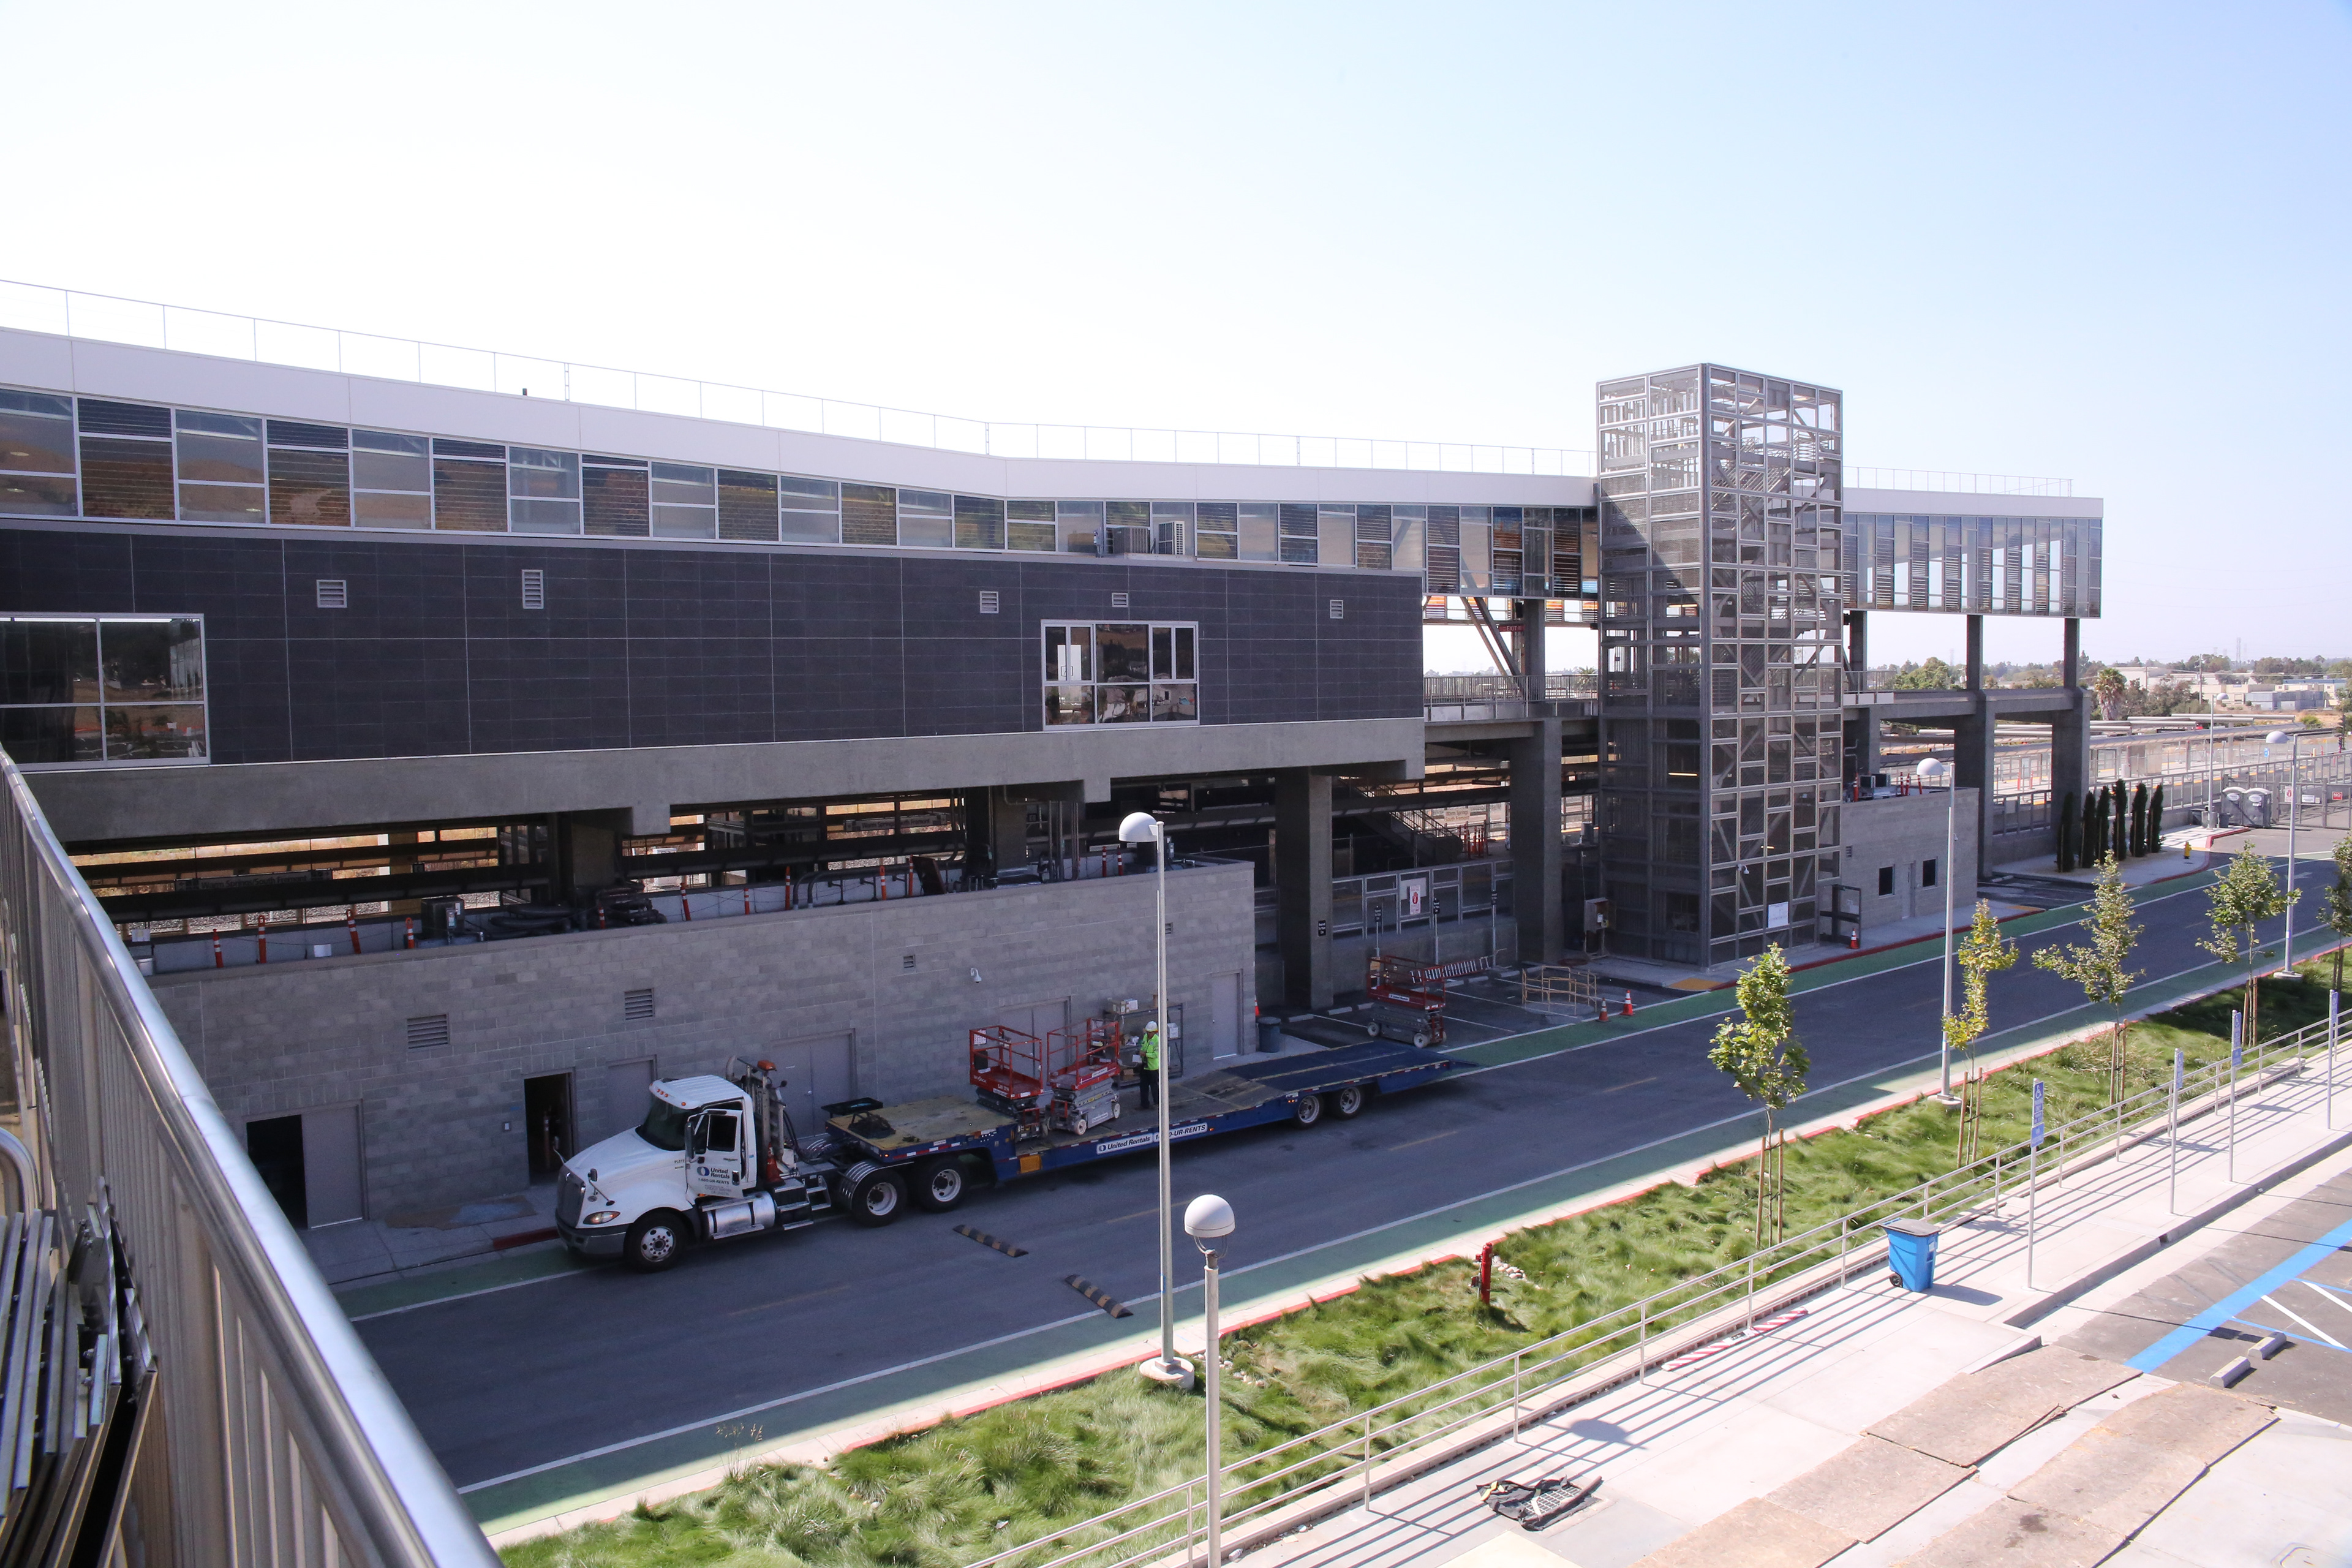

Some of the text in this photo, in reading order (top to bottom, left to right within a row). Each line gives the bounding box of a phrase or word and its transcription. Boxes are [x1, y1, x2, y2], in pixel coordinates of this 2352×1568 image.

[1155, 1124, 1206, 1140] 1-0-UR-RENTS
[1107, 1136, 1150, 1150] United Rentals
